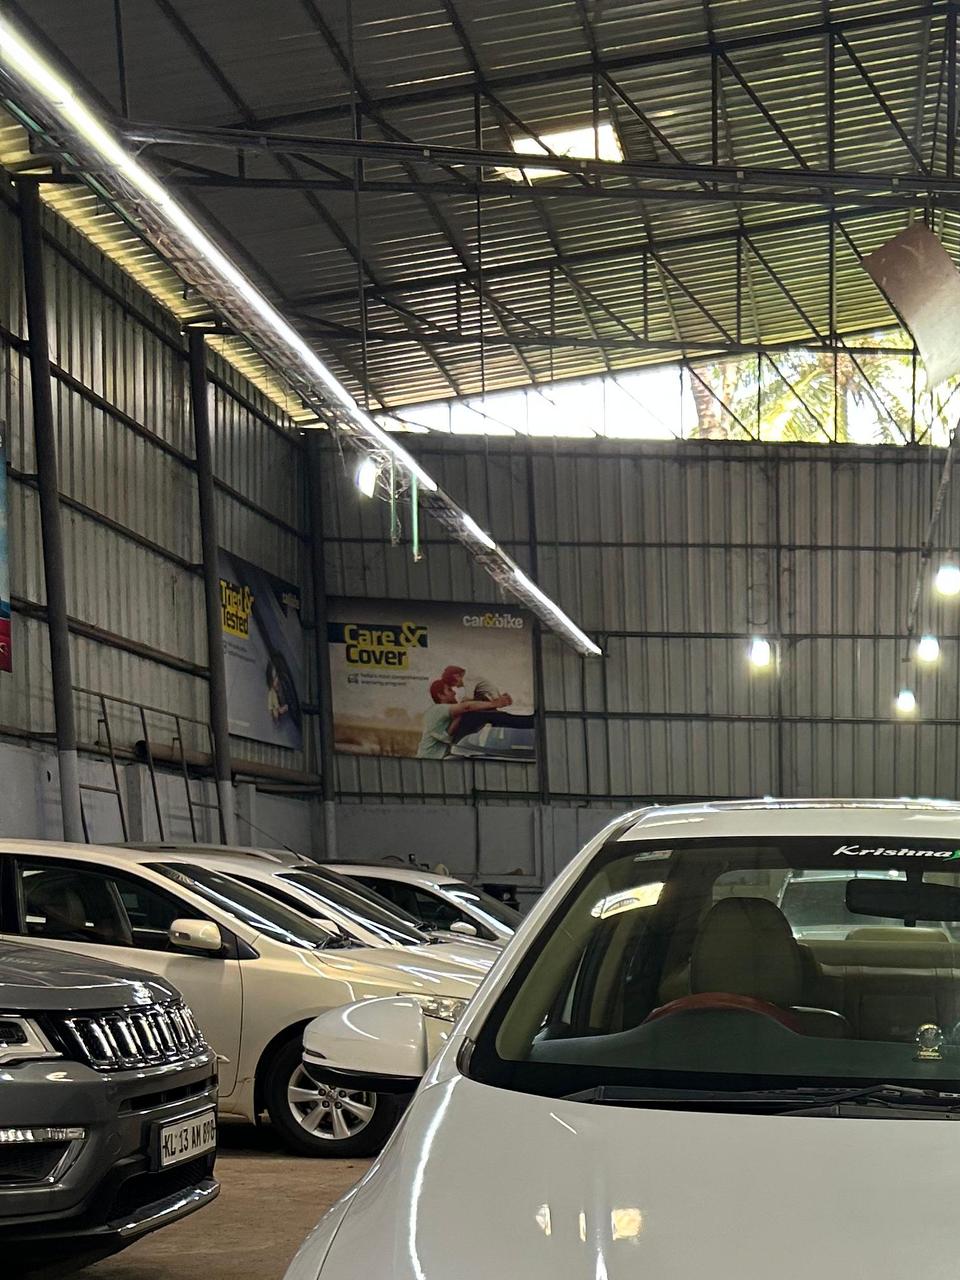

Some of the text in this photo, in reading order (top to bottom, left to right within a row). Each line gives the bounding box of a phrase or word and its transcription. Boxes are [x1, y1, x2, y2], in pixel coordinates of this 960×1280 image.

[222, 605, 249, 635] Tested
[463, 613, 524, 629] car&bike
[345, 622, 428, 648] Care &
[346, 645, 406, 665] Cover
[833, 845, 953, 857] Krishna
[164, 1133, 176, 1158] KL
[179, 1128, 188, 1153] 13
[192, 1125, 201, 1149] AM
